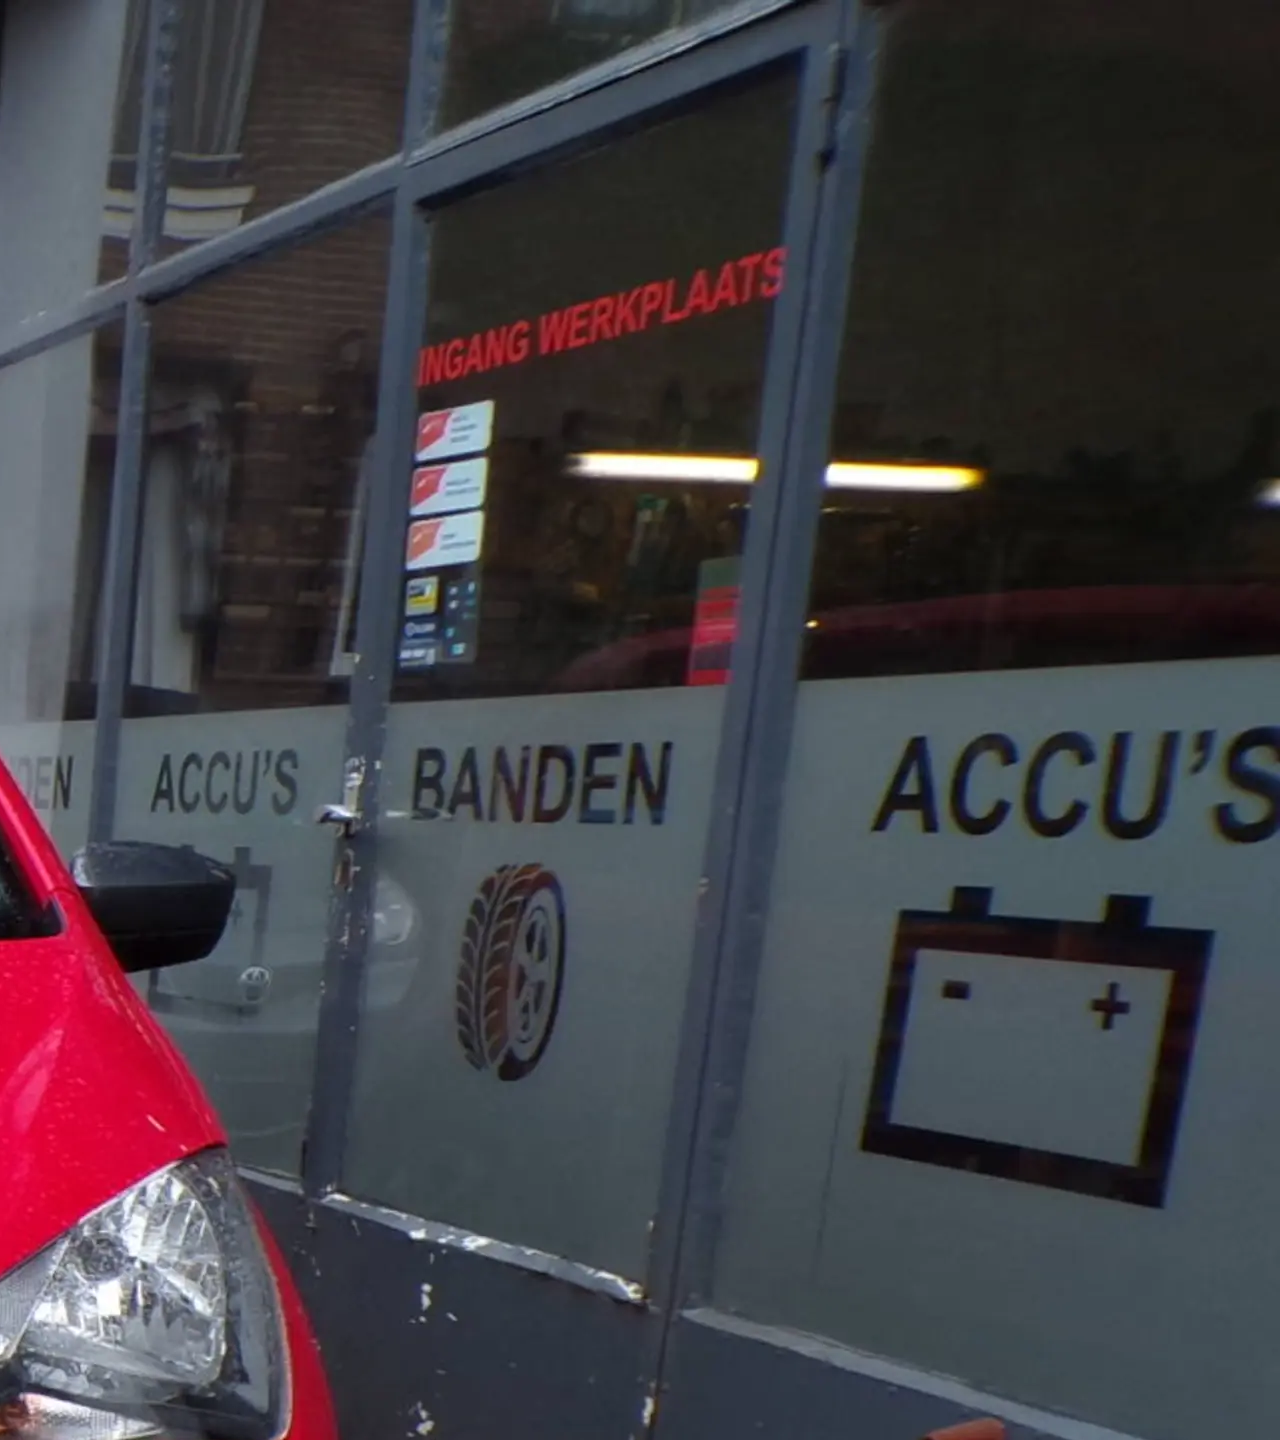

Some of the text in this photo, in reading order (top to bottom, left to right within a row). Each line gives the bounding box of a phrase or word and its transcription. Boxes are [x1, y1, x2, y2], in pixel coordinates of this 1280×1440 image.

[416, 246, 787, 387] INGANG WERKPLAATS
[10, 756, 73, 811] DEN
[151, 748, 299, 815] ACCU'S
[410, 741, 674, 826] BANDEN
[871, 726, 1280, 844] ACCU'S
